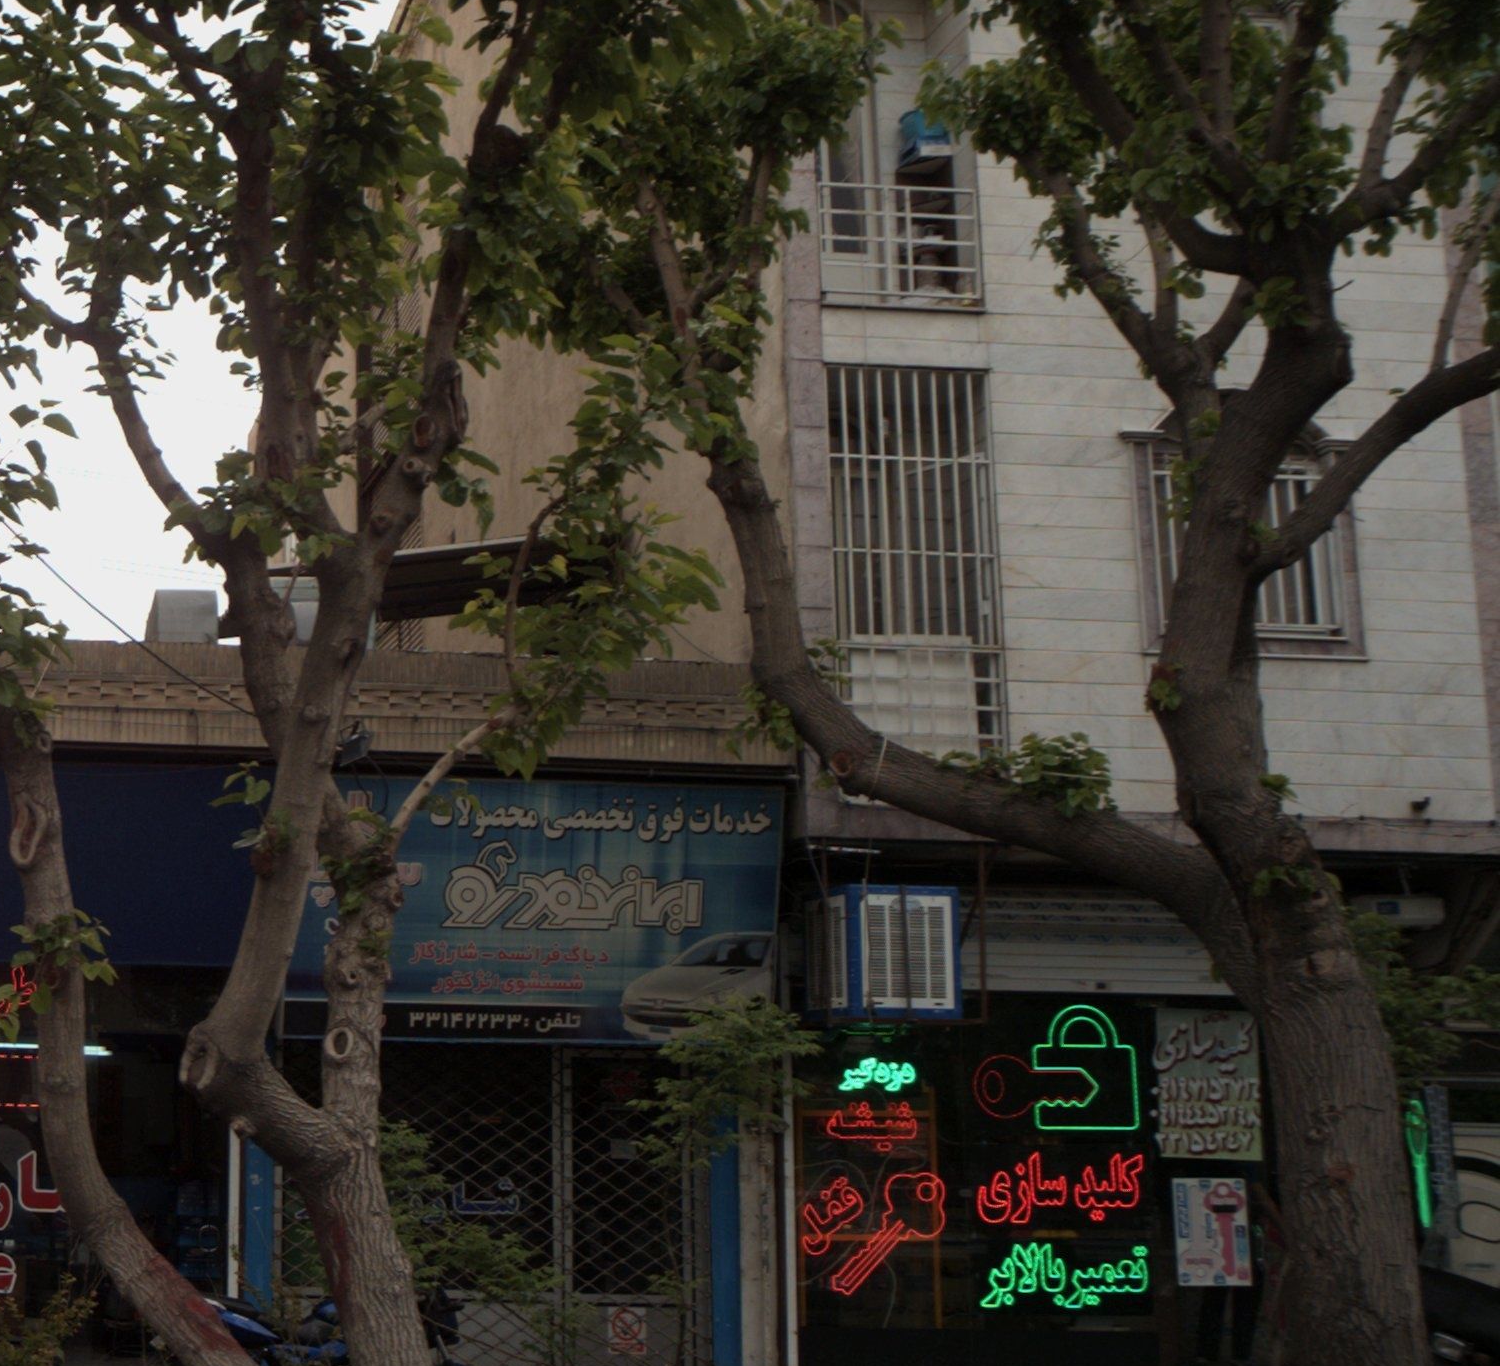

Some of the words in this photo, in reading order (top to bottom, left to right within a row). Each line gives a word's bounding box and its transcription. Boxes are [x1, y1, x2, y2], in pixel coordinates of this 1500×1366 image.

[542, 796, 635, 841] تخصصی
[638, 796, 684, 843] فوق
[688, 800, 772, 835] خدمات
[497, 941, 561, 967] فرانسه
[431, 969, 500, 994] انژکتور
[500, 969, 585, 995] شستشوی
[408, 1011, 522, 1030] ۳۳۱۴۲۲۳۳
[825, 1100, 918, 1153] شیشه
[975, 1149, 1070, 1225] سازی
[1073, 1151, 1146, 1224] کلید
[803, 1176, 864, 1256] قفل
[1063, 1244, 1150, 1310] تعمیر
